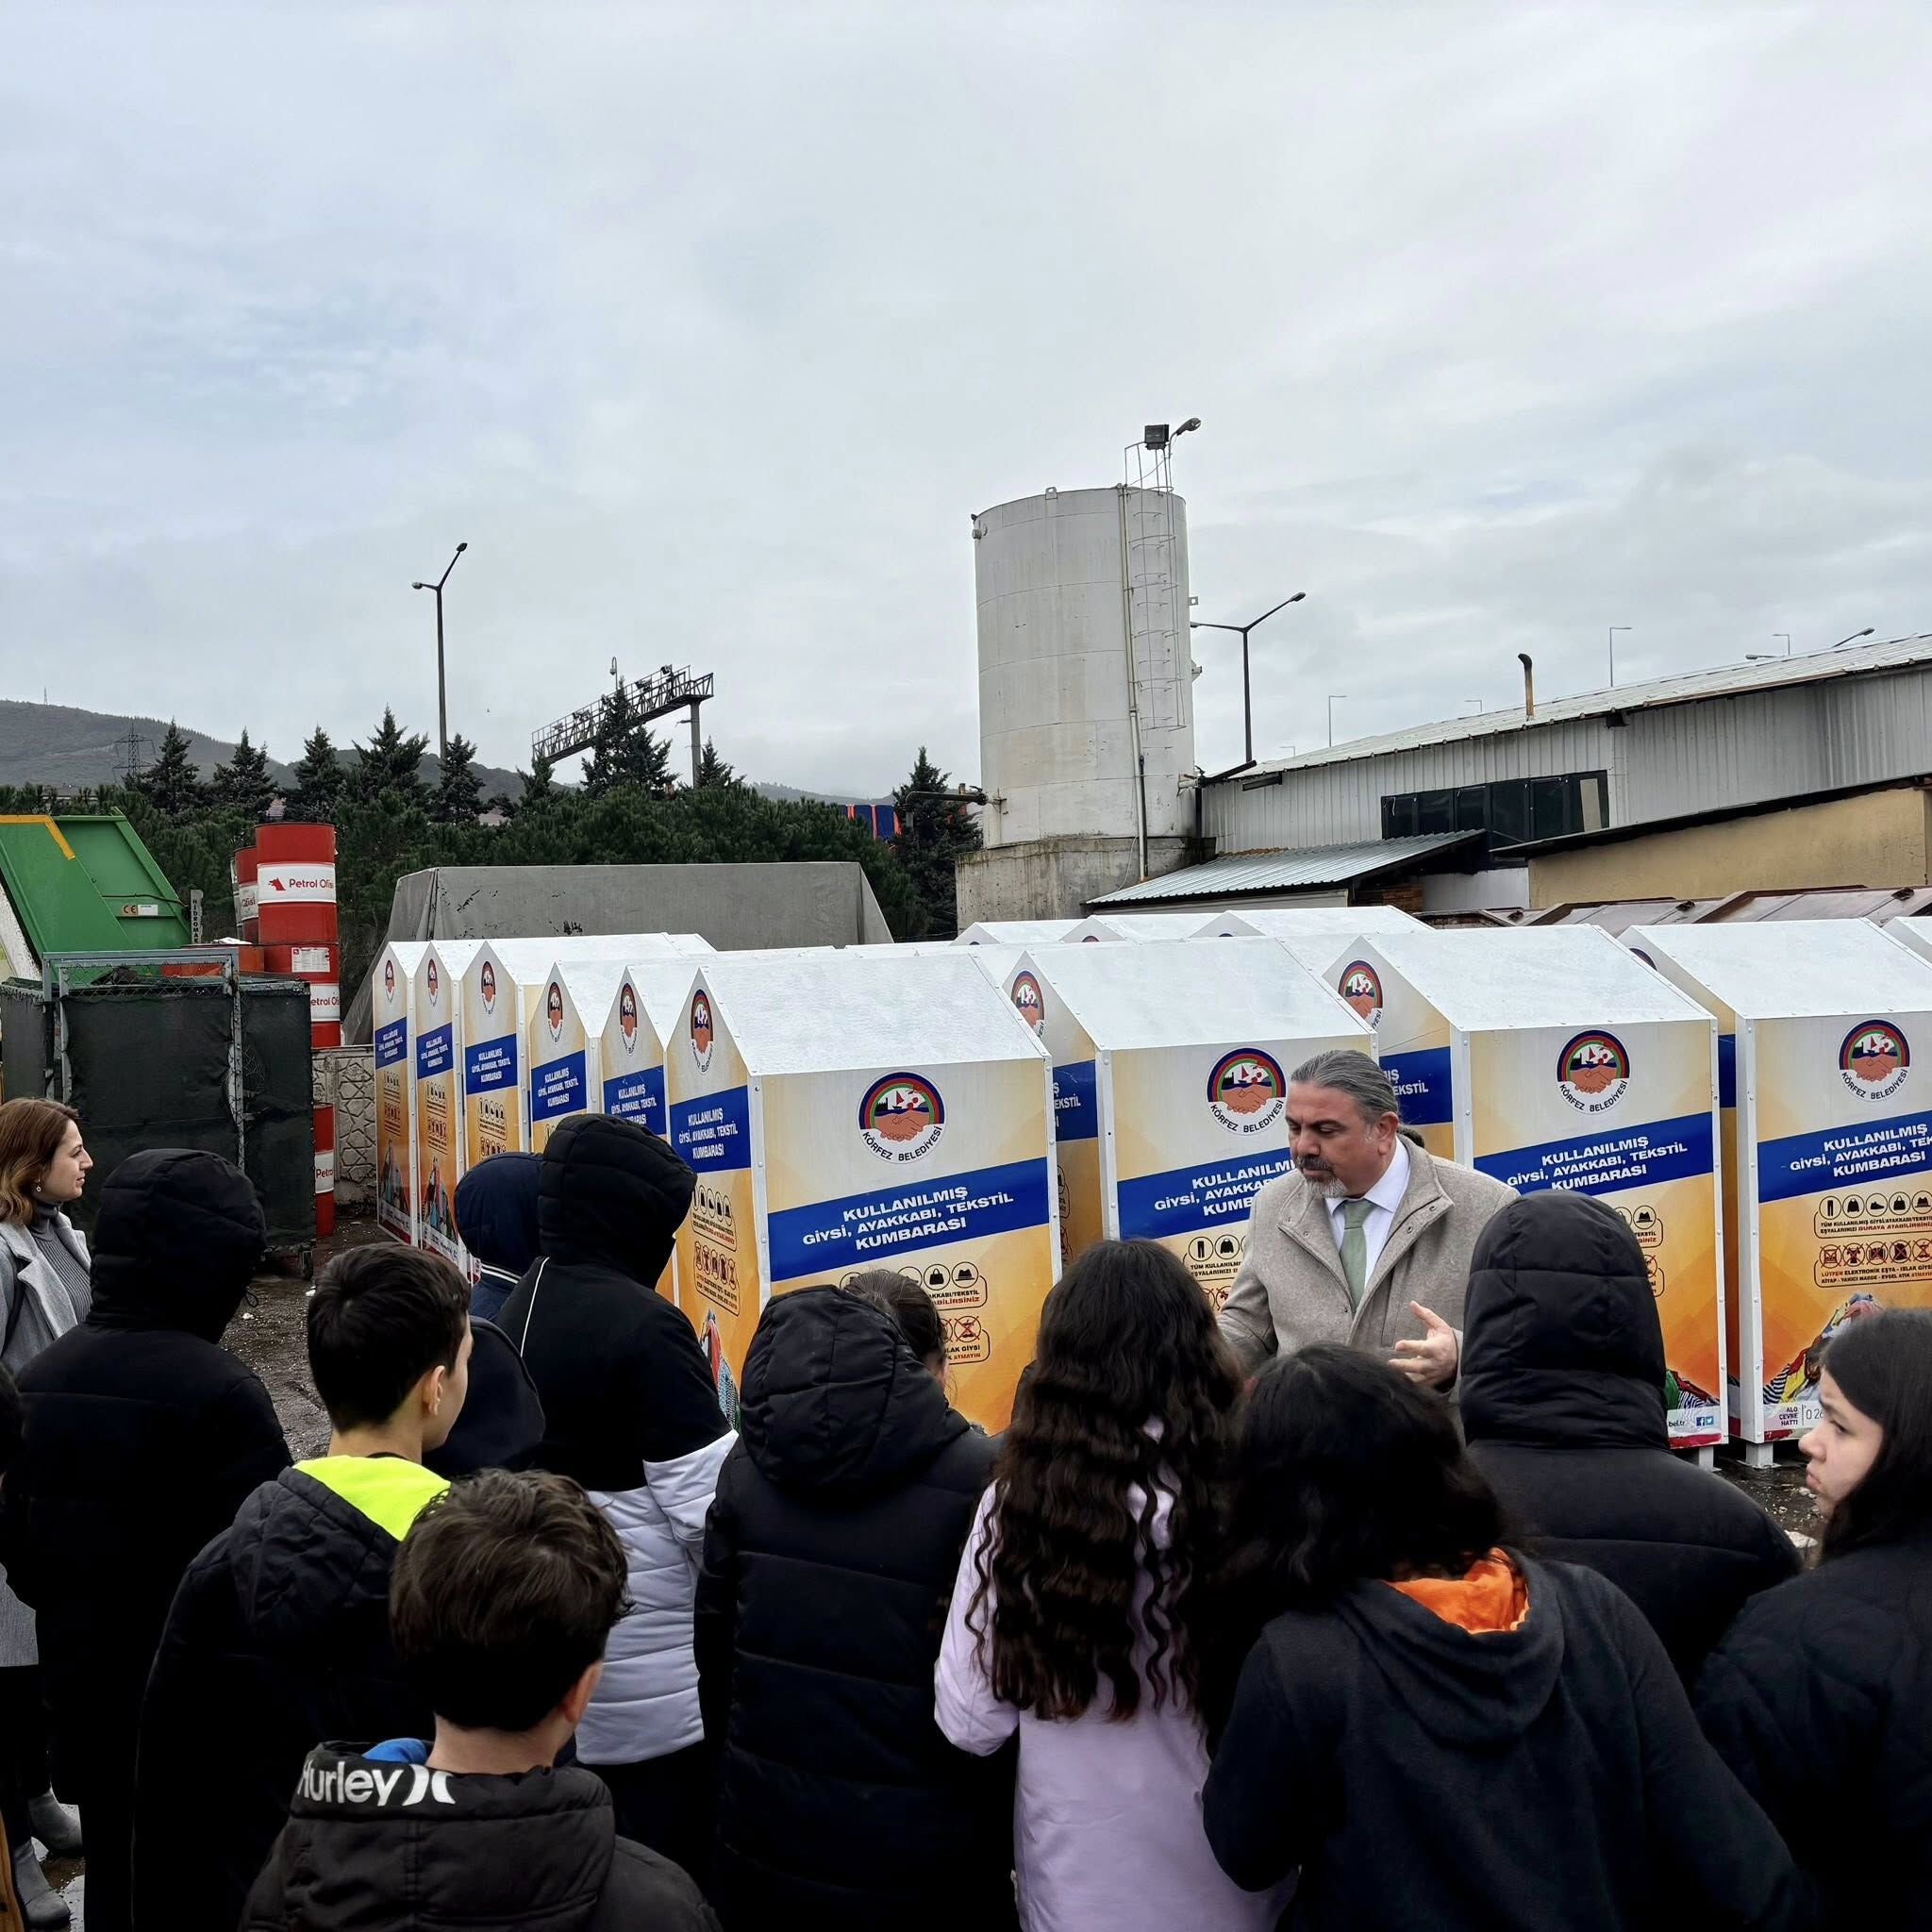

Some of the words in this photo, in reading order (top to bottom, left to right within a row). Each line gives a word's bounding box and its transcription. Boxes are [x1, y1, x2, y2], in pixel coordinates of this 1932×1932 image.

[289, 878, 318, 889] Petrol
[309, 997, 330, 1007] etrol
[1393, 1079, 1429, 1095] EKSTİL
[1558, 1083, 1586, 1112] KÖRFEZ
[1590, 1079, 1628, 1113] BELEDİYESİ
[1840, 1072, 1867, 1099] KÖRFEZ
[1871, 1069, 1908, 1100] BELEDİYESİ
[687, 1108, 724, 1127] KULLANILMIŞ
[716, 1121, 739, 1138] TEKSTİL
[1209, 1104, 1239, 1132] KÖRFEZ
[1243, 1099, 1284, 1134] BELEDİYESİ
[691, 1143, 724, 1159] KUMBARASI
[862, 1131, 893, 1160] KÖRFEZ
[898, 1125, 942, 1161] BELEDİYESİ
[1541, 1136, 1649, 1167] KULLANILMIŞ
[1824, 1124, 1928, 1152] KULLANILMIŞ
[1507, 1168, 1549, 1187] GİYSİ,
[1553, 1156, 1626, 1178] AYAKKABI,
[1629, 1141, 1688, 1162] TEKSTİL
[1790, 1154, 1831, 1172] GİYSİ,
[1835, 1141, 1906, 1163] AYAKKABI,
[1833, 1151, 1926, 1177] KUMBARASI
[1191, 1158, 1297, 1191] KULLANILMI
[1551, 1164, 1647, 1191] KUMBARASI
[842, 1186, 968, 1223] KULLANILMIŞ
[1154, 1189, 1200, 1211] GİYSİ,
[802, 1224, 852, 1245] GİYSİ,
[857, 1208, 942, 1234] AYAKKABI,
[945, 1191, 1014, 1215] TEKSTİL
[855, 1216, 967, 1251] KUMBARASI
[296, 1758, 405, 1807] Hurley
